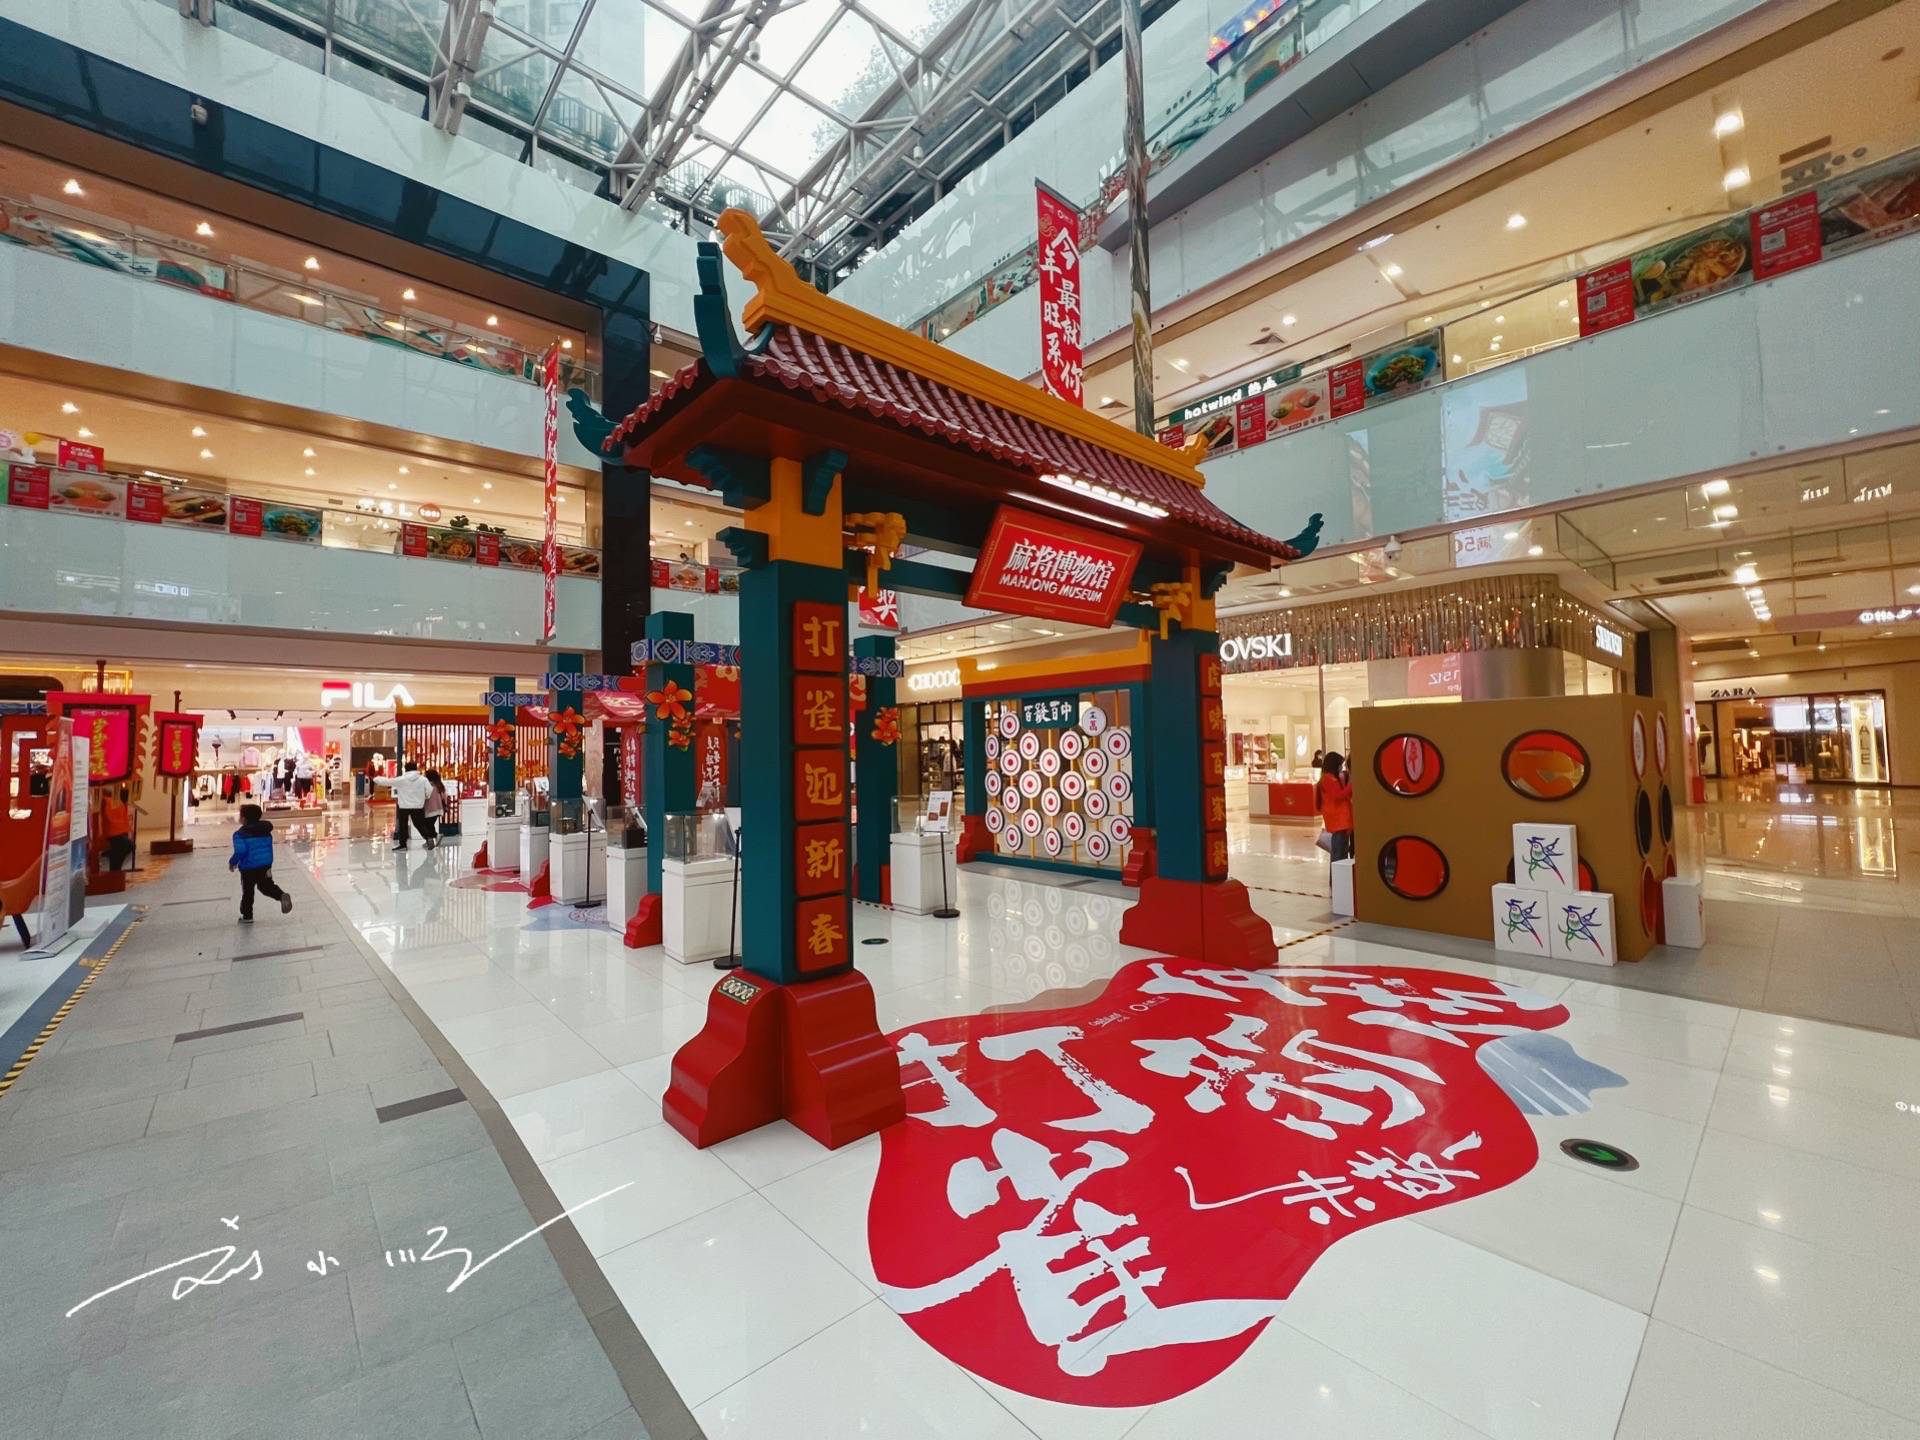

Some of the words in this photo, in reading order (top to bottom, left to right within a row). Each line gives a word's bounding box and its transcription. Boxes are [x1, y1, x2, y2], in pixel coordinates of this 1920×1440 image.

[1184, 388, 1242, 420] hotwind
[1003, 537, 1116, 590] 麻将博物馆
[999, 573, 1058, 594] MAHJONG
[1058, 585, 1103, 603] MUSEUM
[1220, 633, 1292, 661] OVSKI
[321, 681, 415, 708] FILA
[1710, 687, 1758, 698] ZARA
[1024, 701, 1072, 724] 百發百中
[1857, 706, 1871, 766] SALE
[802, 615, 843, 956] 打雀迎新春
